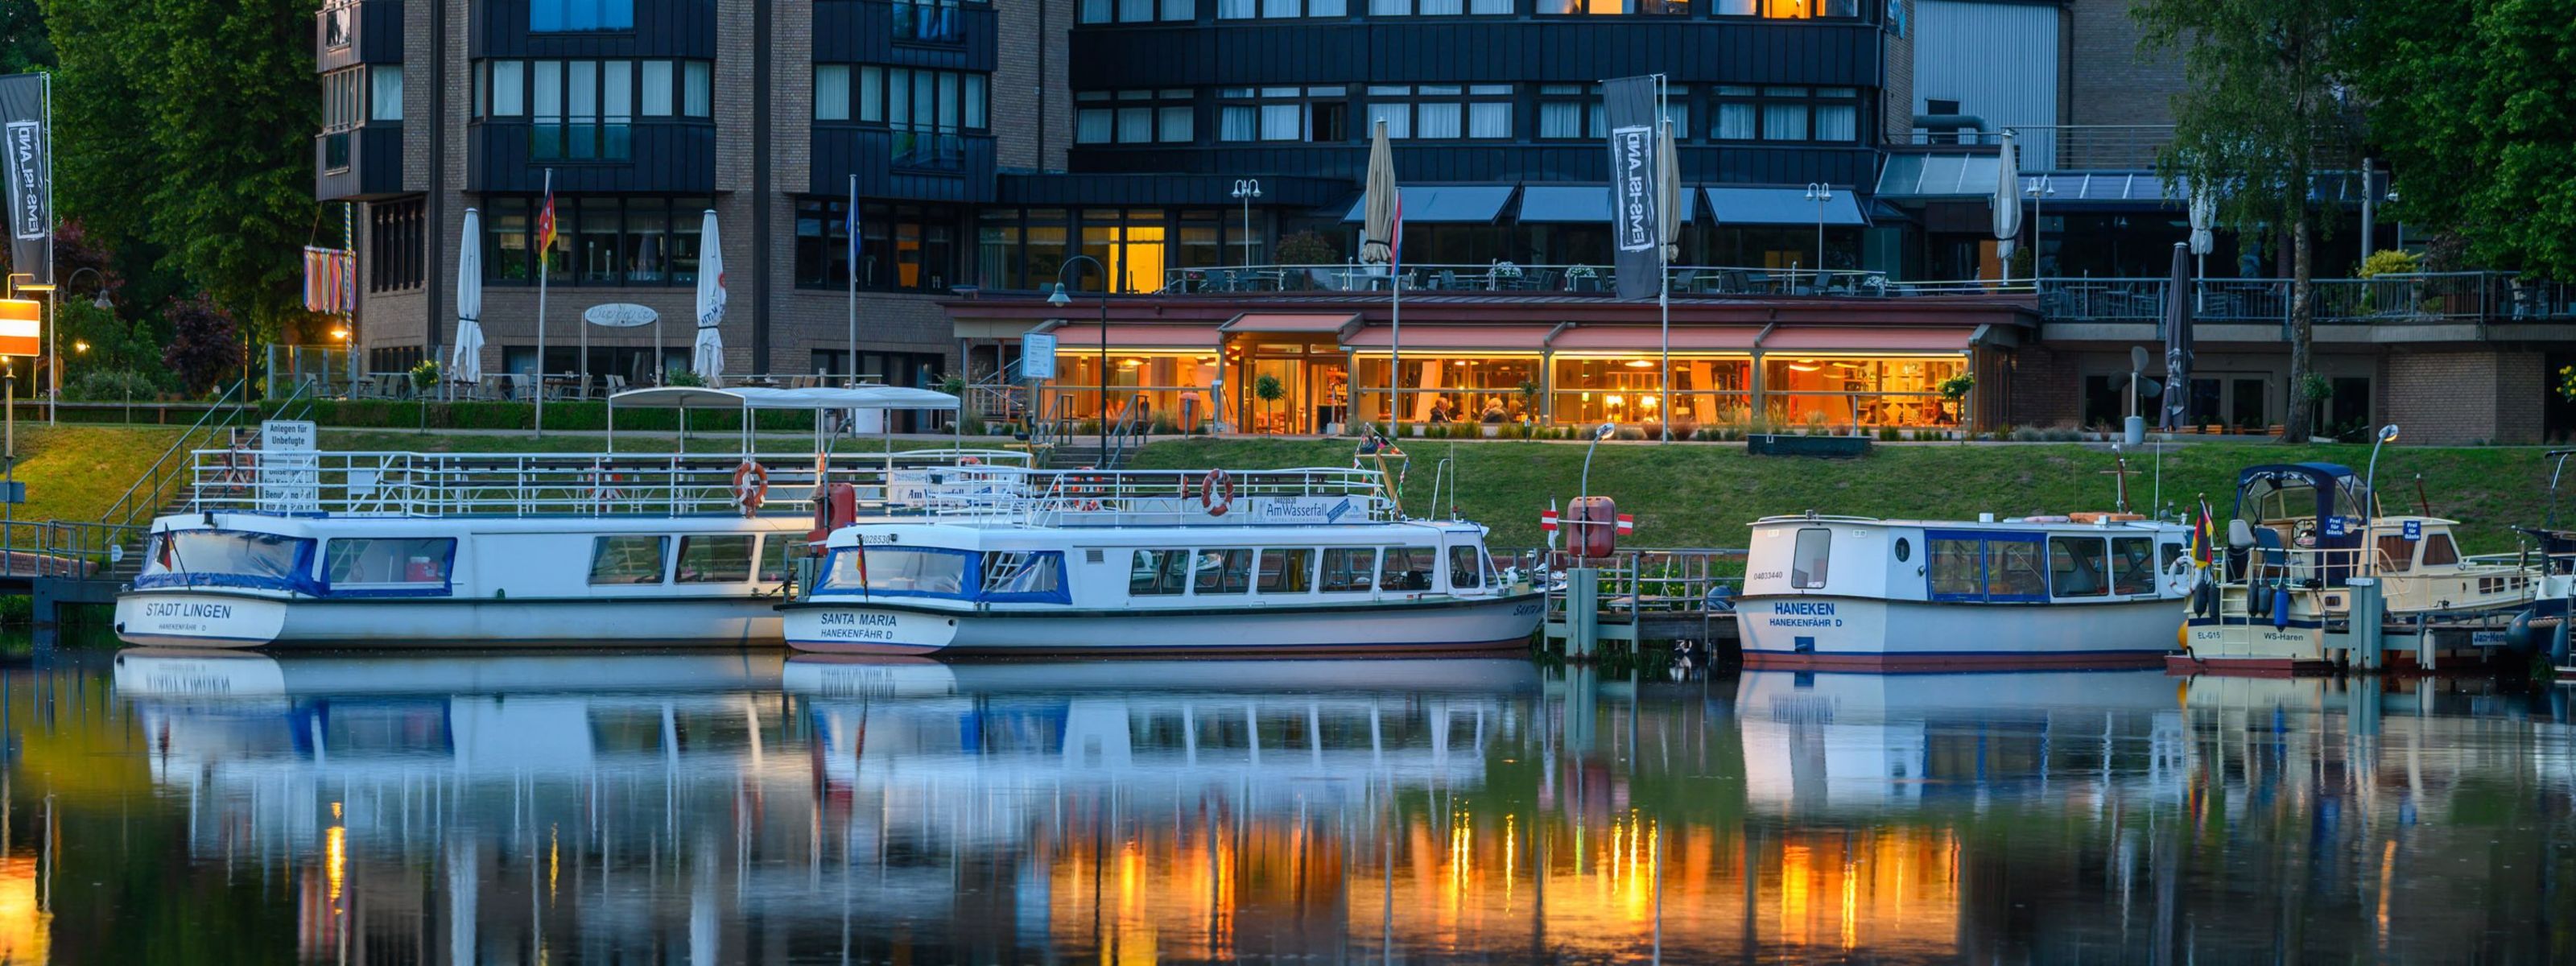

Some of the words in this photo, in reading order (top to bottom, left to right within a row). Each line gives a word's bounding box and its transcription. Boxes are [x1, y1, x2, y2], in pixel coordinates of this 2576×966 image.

[270, 423, 296, 434] Anlegen
[298, 423, 308, 433] für
[272, 436, 305, 447] Unbefugte
[1754, 572, 1783, 580] 04033440
[146, 603, 181, 617] STADT
[184, 604, 232, 619] LINGEN
[1774, 602, 1835, 616] HANEKEN
[821, 613, 854, 625] SANTA
[859, 613, 897, 626] MARIA
[1769, 617, 1831, 626] HANEKENFÄHR
[1835, 619, 1843, 627] D
[821, 629, 882, 639] HANEKENFÄHR
[886, 630, 893, 639] D
[2198, 631, 2220, 639] EL-G15
[2264, 632, 2304, 642] WS-Haren
